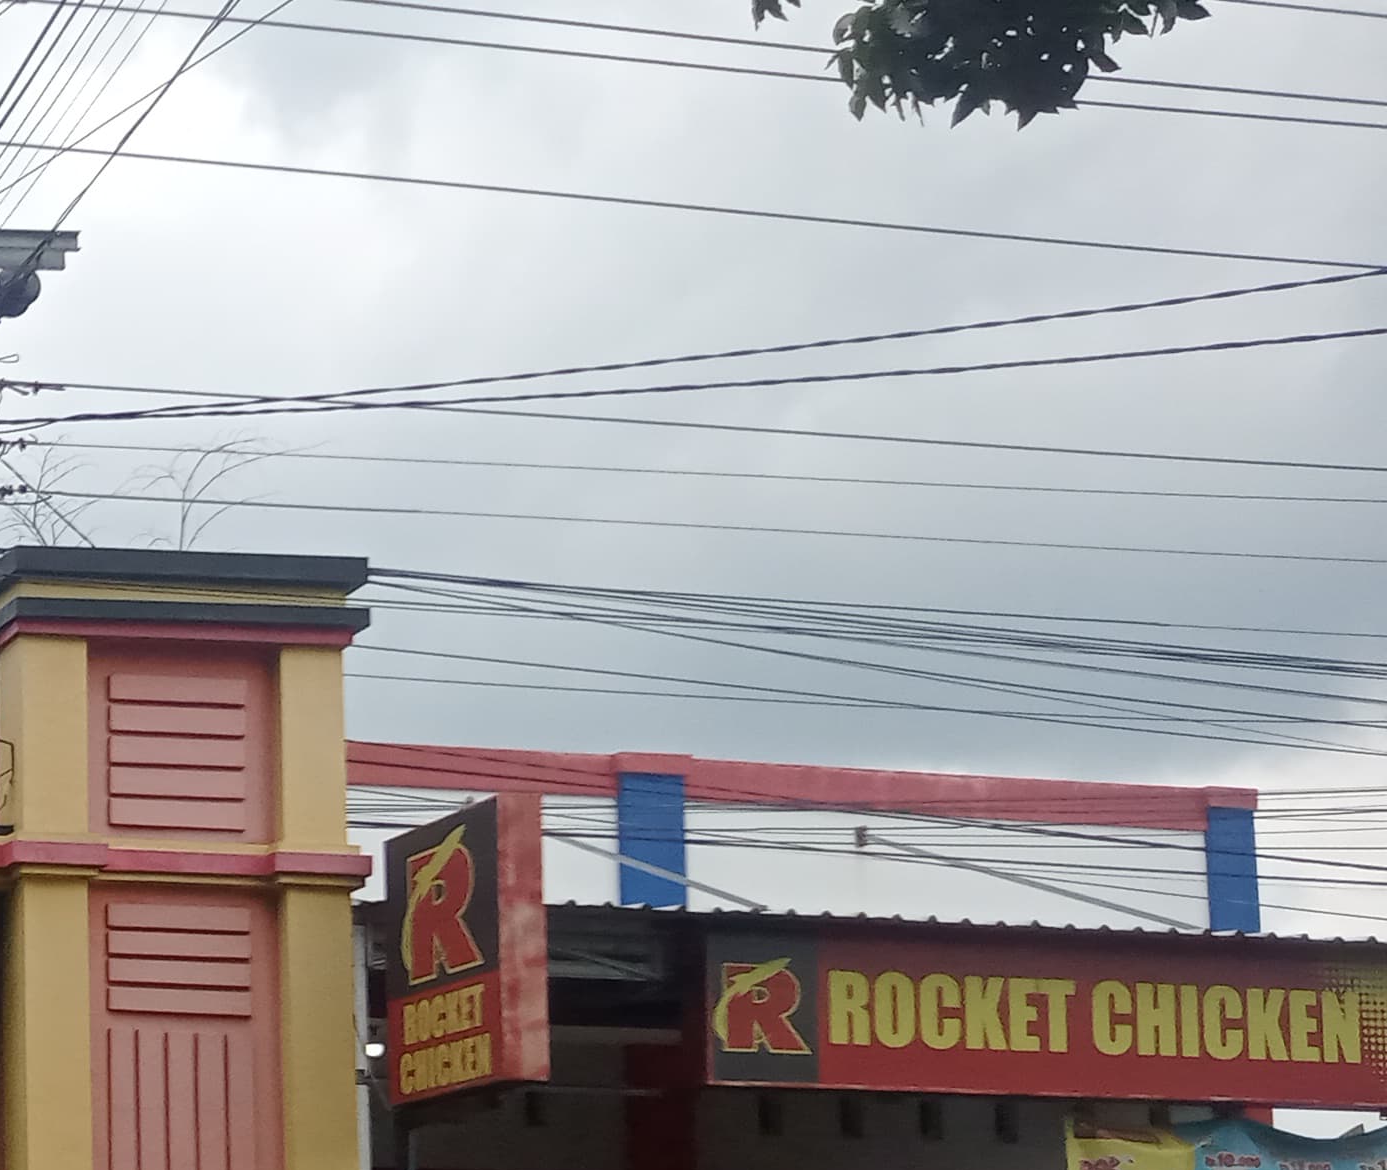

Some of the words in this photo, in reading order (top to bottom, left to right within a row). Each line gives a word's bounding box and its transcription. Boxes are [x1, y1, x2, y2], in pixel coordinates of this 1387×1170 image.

[403, 983, 485, 1045] ROCKET
[828, 969, 1076, 1053] ROCKET
[1091, 980, 1362, 1065] CHICKEN
[400, 1032, 492, 1095] CHICKEN
